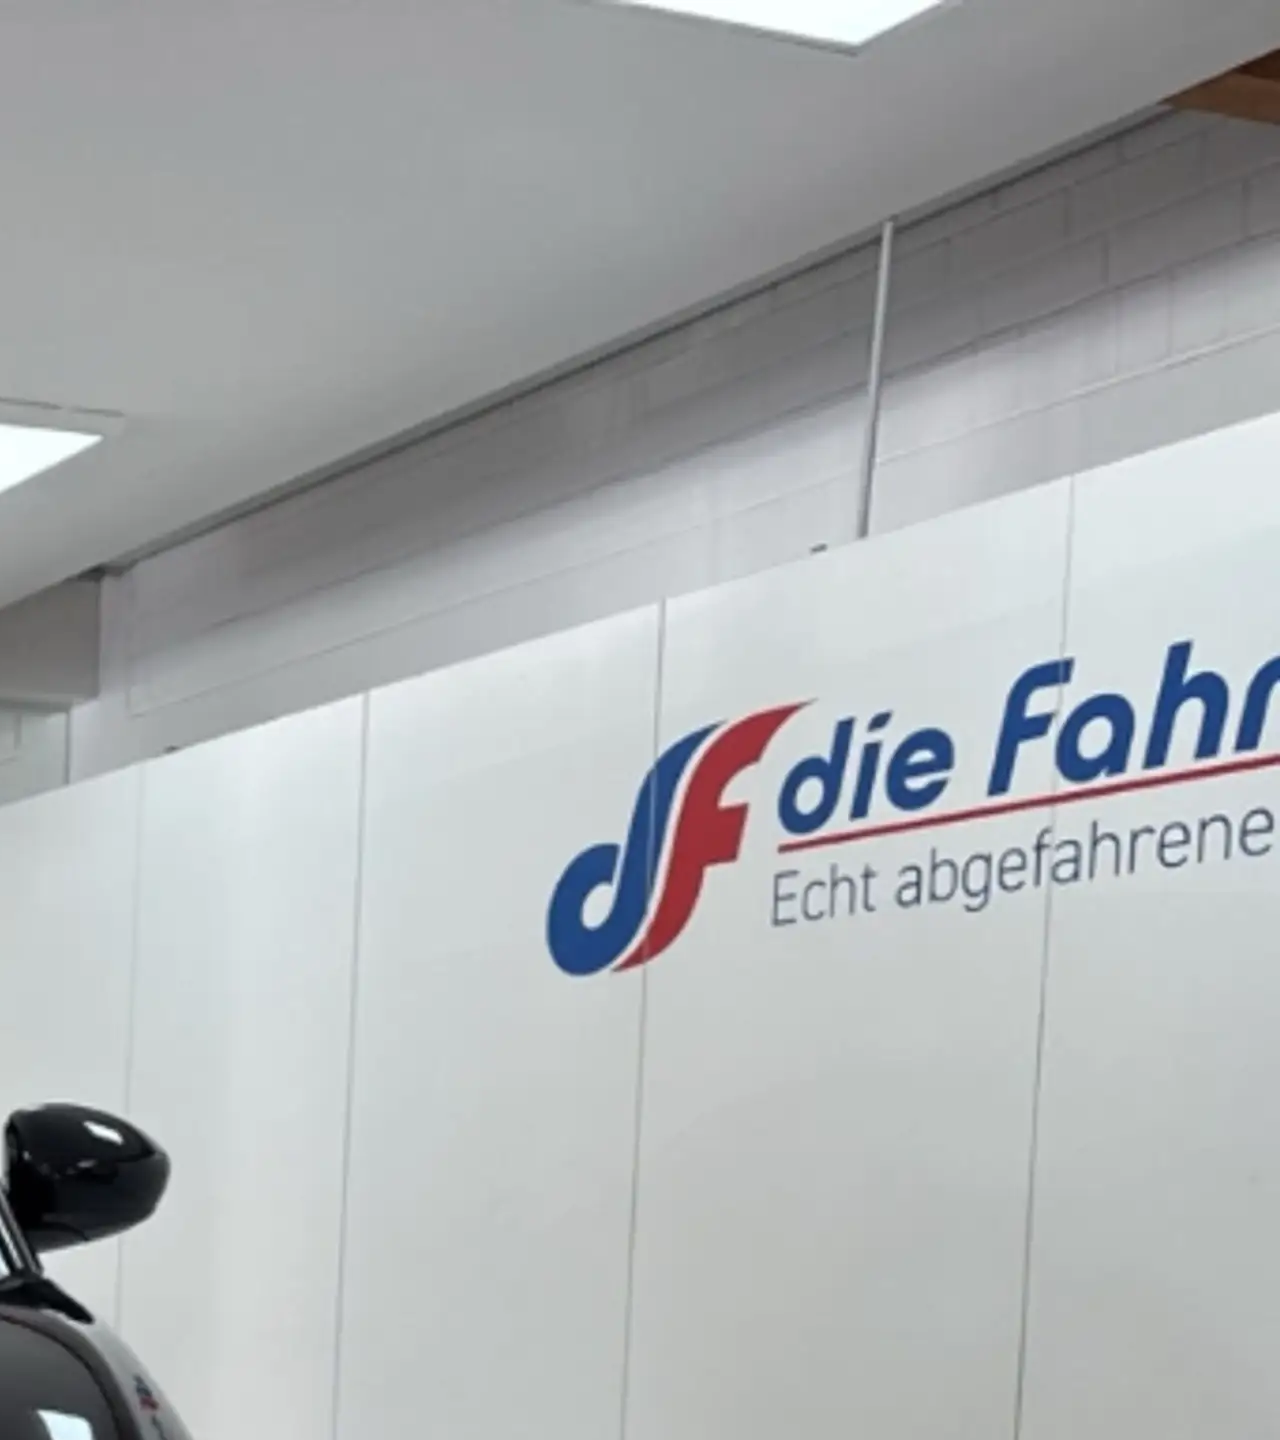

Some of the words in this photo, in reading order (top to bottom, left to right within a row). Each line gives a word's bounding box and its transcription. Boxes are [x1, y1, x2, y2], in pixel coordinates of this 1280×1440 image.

[777, 710, 954, 834] die
[986, 640, 1280, 797] Fahr
[771, 864, 877, 927] Echt
[894, 806, 1275, 913] abgefahrene
